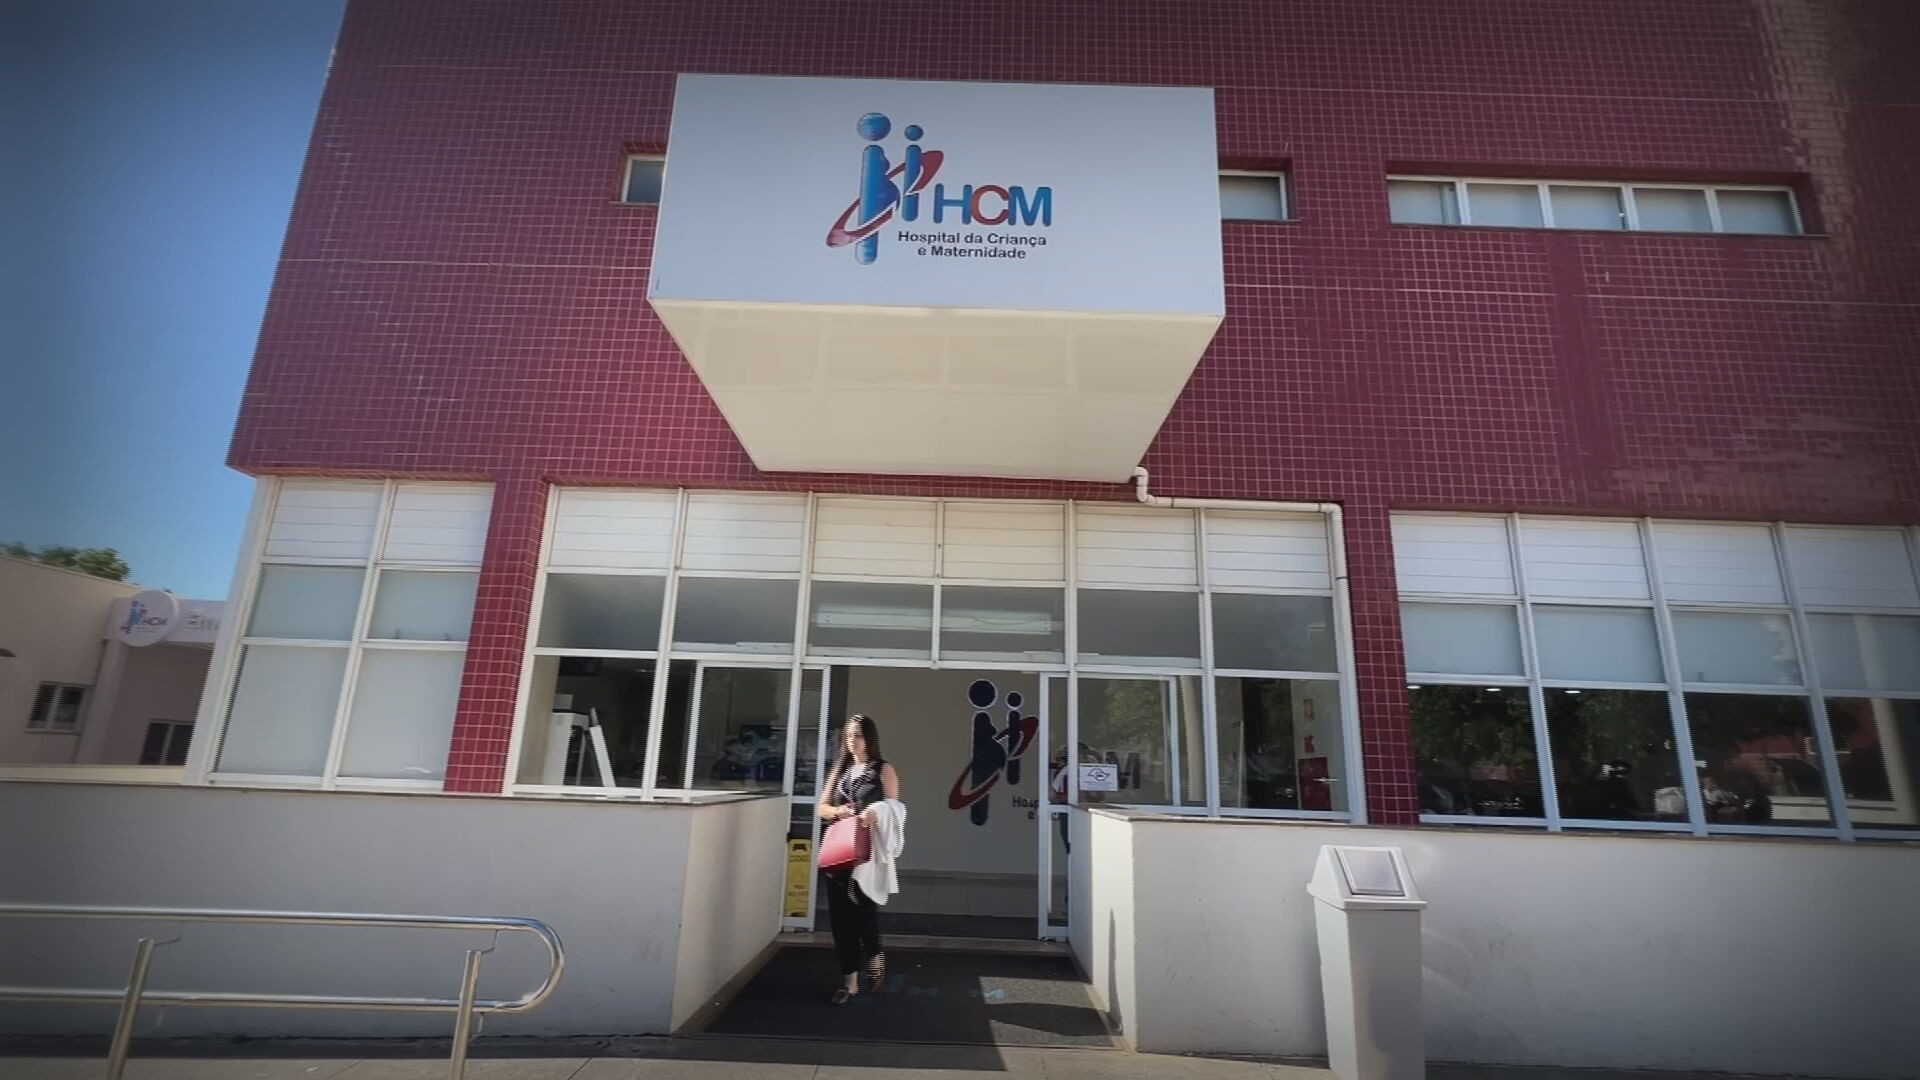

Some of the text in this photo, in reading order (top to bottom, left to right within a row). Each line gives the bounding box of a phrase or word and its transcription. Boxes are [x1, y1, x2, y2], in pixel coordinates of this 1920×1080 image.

[933, 183, 1052, 227] HCM
[898, 231, 1047, 247] Hospital da Criança
[917, 246, 1026, 259] e Maternidade
